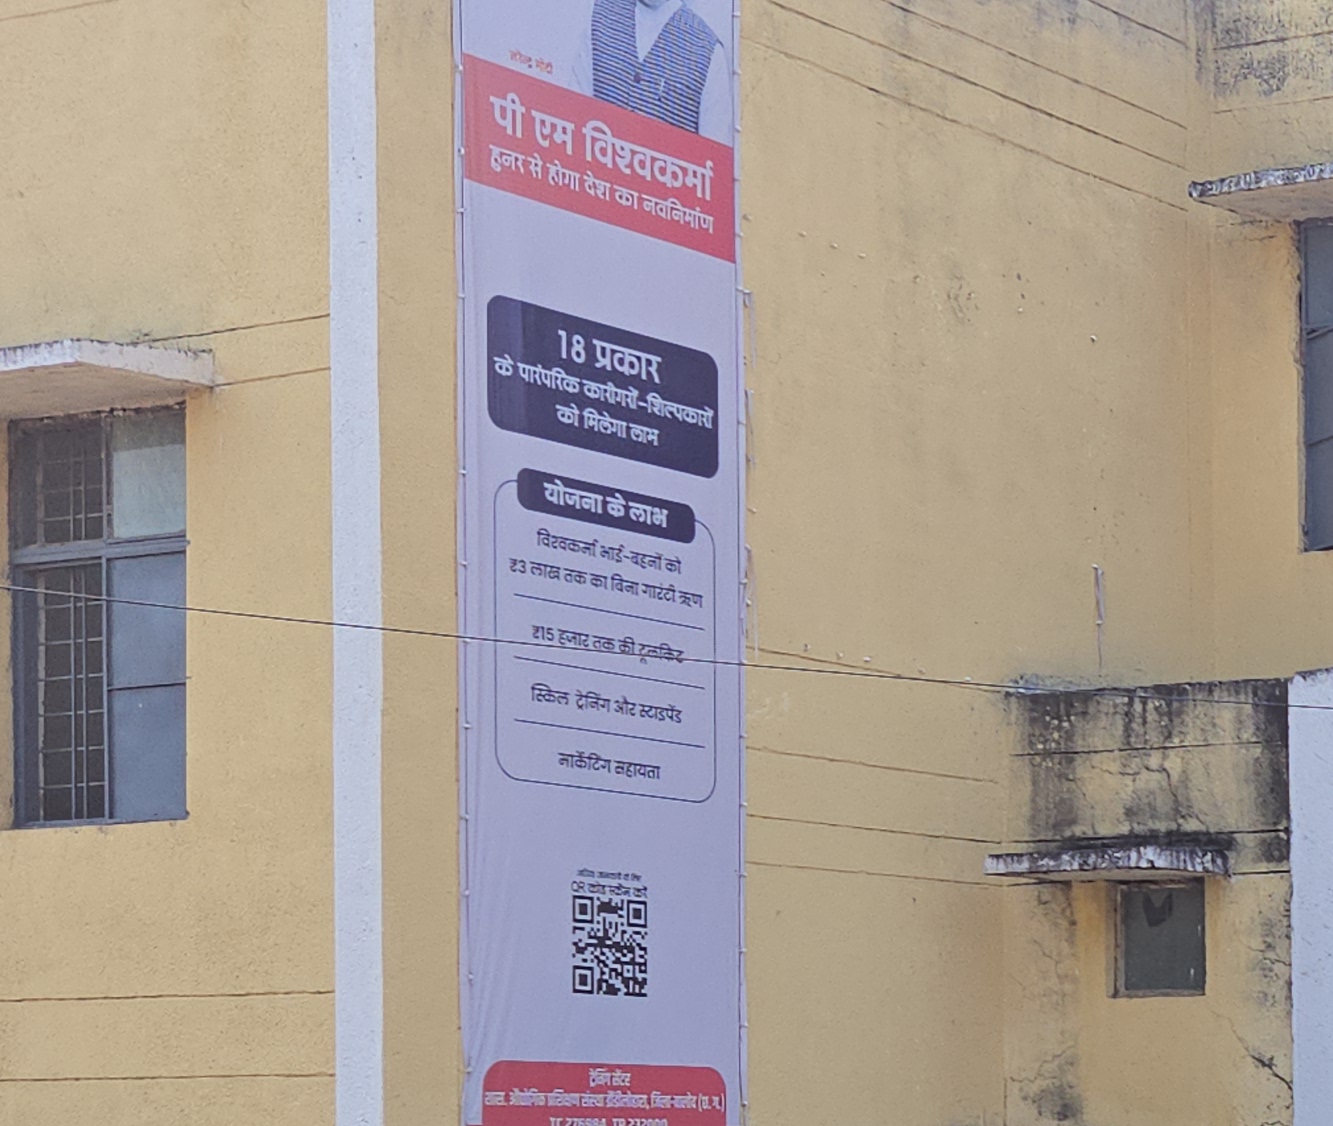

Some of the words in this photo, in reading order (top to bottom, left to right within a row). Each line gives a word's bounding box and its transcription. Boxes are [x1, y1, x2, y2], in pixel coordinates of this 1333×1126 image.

[489, 93, 526, 138] पी
[531, 109, 574, 155] एम
[582, 120, 713, 201] विश्वकर्मा
[489, 145, 525, 173] हुनर
[527, 153, 542, 179] से
[547, 161, 580, 192] होगा
[584, 171, 610, 201] देश
[614, 185, 639, 210] का
[642, 194, 714, 234] नवनिर्माण
[493, 354, 514, 377] के
[517, 361, 580, 394] पारंपरिक
[557, 329, 587, 364] 18
[592, 337, 662, 384] प्रकार
[555, 403, 579, 427] को
[583, 408, 627, 438] मिलेगा
[544, 479, 603, 514] योजना
[606, 493, 626, 517] के
[628, 501, 669, 527] लाभ
[530, 561, 561, 581] लाख
[563, 567, 588, 585] तक
[589, 574, 608, 591] का
[678, 591, 703, 609] ऋण
[664, 556, 682, 575] को
[592, 636, 616, 651] तक
[618, 636, 636, 656] की
[530, 682, 570, 705] स्किल
[613, 696, 636, 717] और
[571, 880, 585, 893] QR
